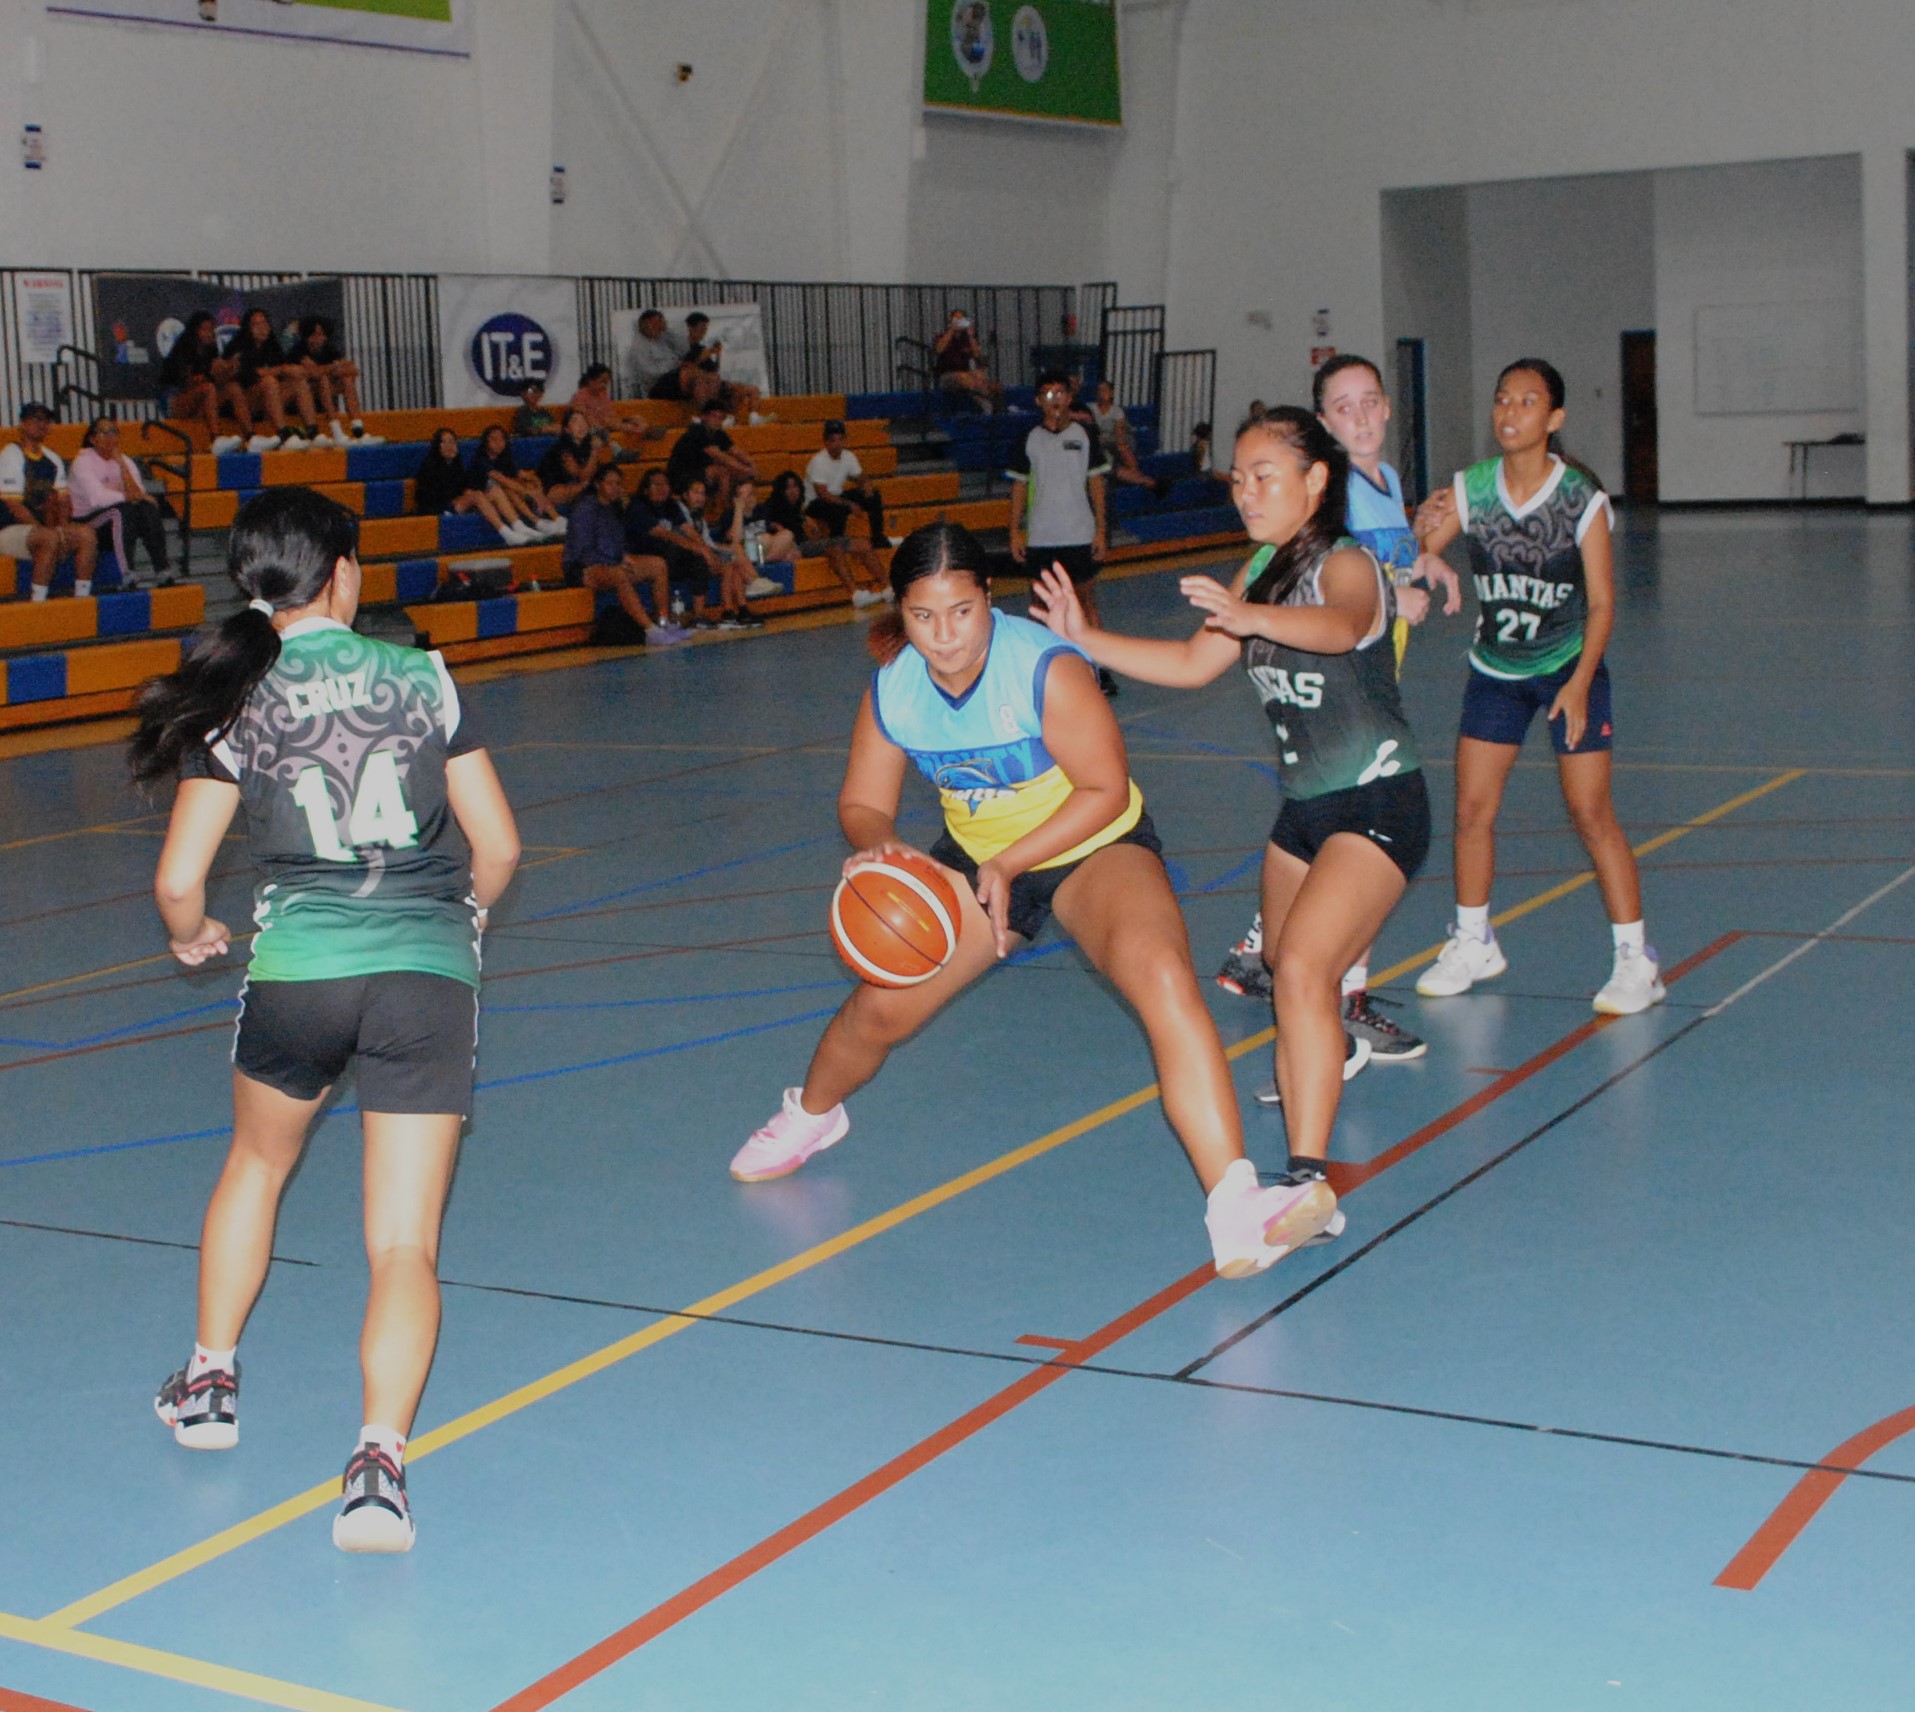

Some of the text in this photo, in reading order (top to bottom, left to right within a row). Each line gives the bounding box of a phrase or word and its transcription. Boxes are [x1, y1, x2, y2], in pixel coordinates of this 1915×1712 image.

[481, 332, 547, 380] IT&E
[1496, 608, 1541, 642] 27
[286, 672, 372, 719] CRUZ
[293, 749, 418, 862] 14
